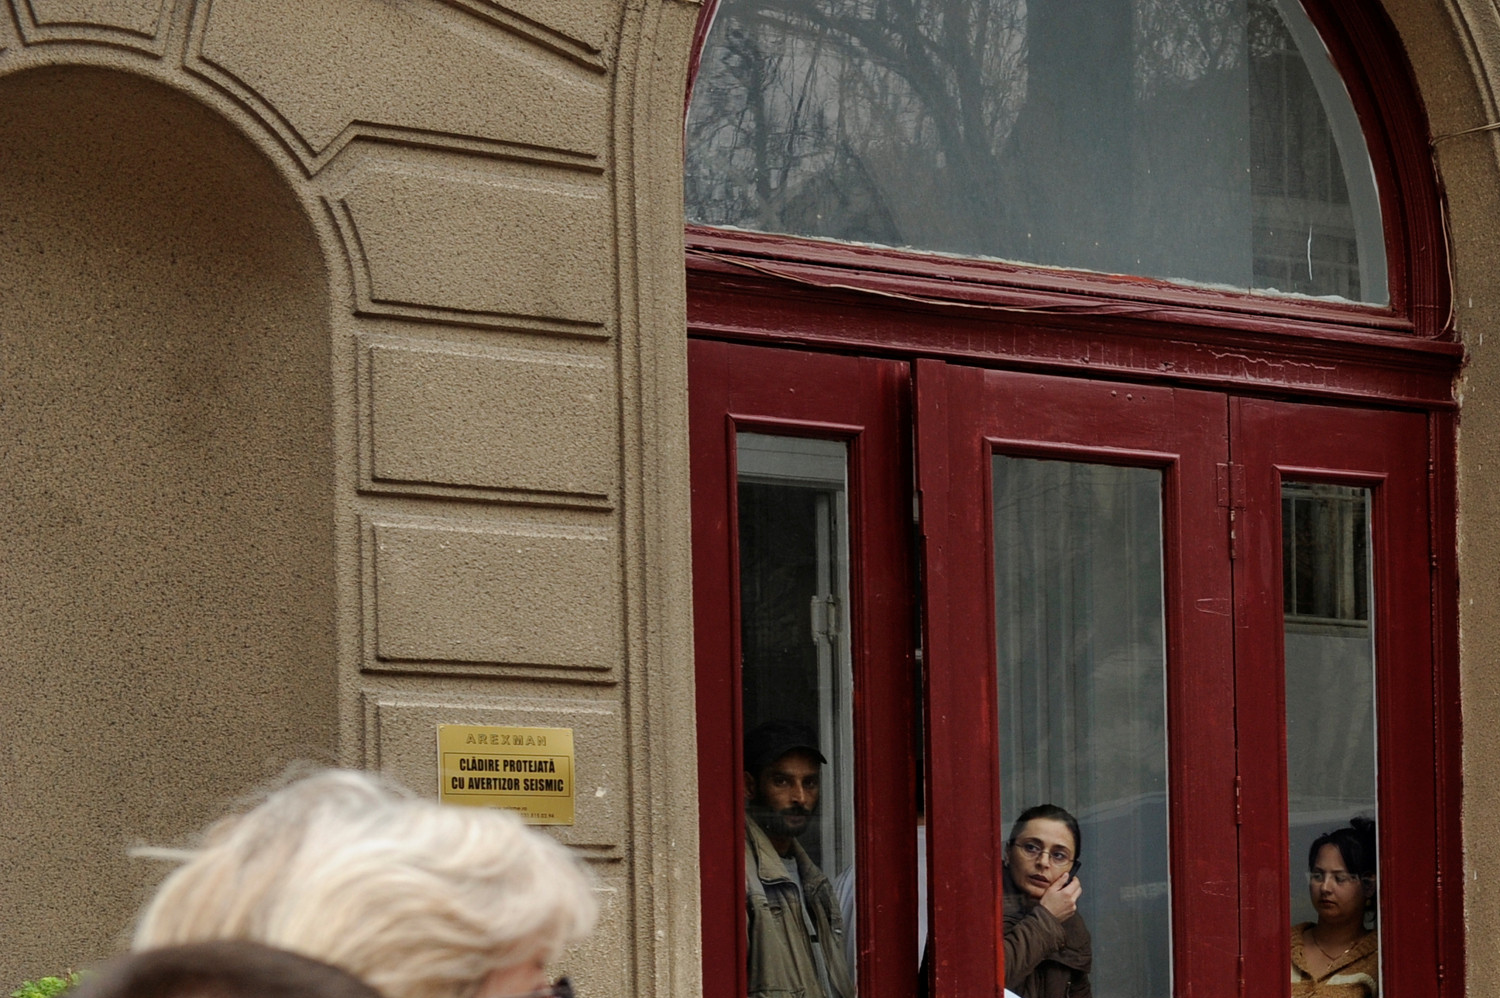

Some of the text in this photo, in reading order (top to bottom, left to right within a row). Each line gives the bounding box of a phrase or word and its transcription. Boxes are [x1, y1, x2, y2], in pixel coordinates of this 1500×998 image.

[466, 733, 547, 746] AREXMAN
[459, 756, 556, 773] CLĂDIRE PROTEJATĂ
[451, 776, 564, 792] CU AVERTIZOR SEISMIC
